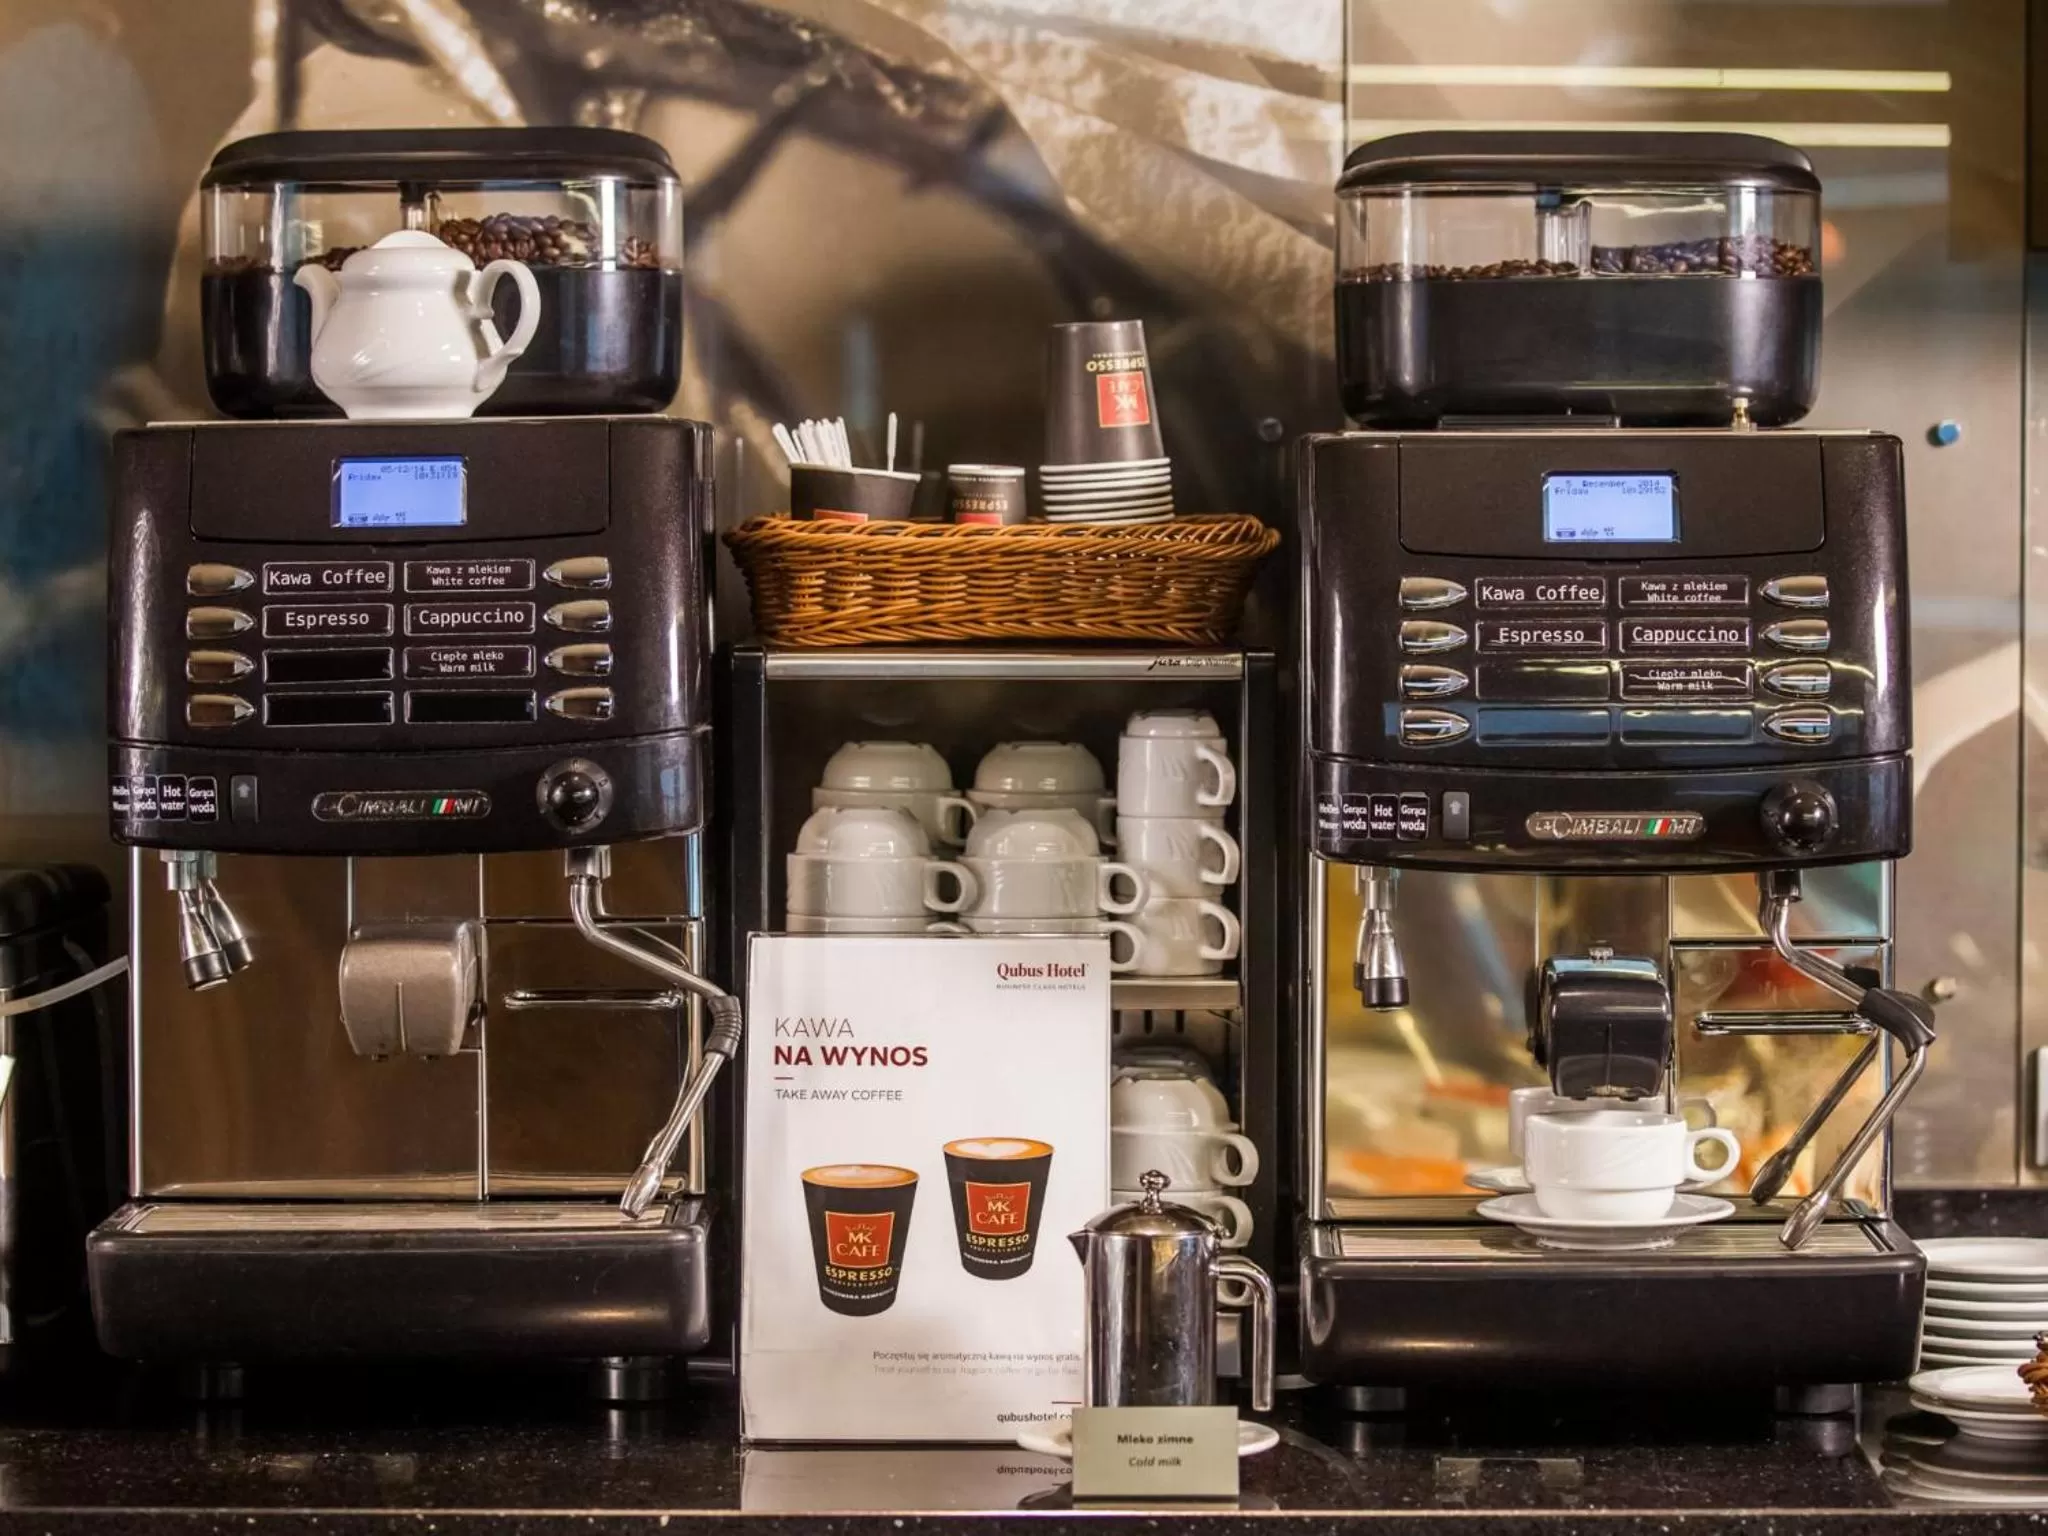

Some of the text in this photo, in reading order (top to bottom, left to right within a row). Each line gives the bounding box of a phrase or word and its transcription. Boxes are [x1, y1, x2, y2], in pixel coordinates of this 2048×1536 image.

[1086, 357, 1146, 372] ESPRESSO
[1582, 480, 1626, 488] December
[1554, 488, 1589, 496] Friday
[426, 566, 450, 574] Kawa
[468, 565, 511, 574] mlekiem
[270, 569, 386, 585] Kawa Coffee
[432, 576, 505, 586] White coffee
[1482, 585, 1600, 600] Kawa Coffee
[1641, 582, 1666, 591] Kawa
[1683, 582, 1728, 591] mlekiem
[1647, 593, 1722, 602] White coffee
[285, 611, 370, 628] Espresso
[418, 609, 525, 627] Cappuccino
[1500, 627, 1584, 645] Espresso
[1632, 626, 1739, 645] Cappuccino
[473, 651, 504, 660] mleko
[439, 663, 495, 673] Warm milk
[1690, 669, 1722, 679] mleko
[1657, 680, 1713, 690] Warm milk
[163, 785, 182, 797] Hot
[133, 799, 157, 810] woda
[160, 801, 185, 811] water
[190, 801, 215, 813] woda
[1374, 804, 1393, 817] Hot
[1343, 818, 1366, 830] woda
[1370, 820, 1396, 830] water
[1400, 819, 1425, 831] woda
[1552, 812, 1641, 839] CIMBALI
[997, 963, 1085, 980] Qubus Hotel
[775, 1017, 854, 1038] KAWA
[774, 1045, 928, 1067] NA WYNOS
[776, 1089, 904, 1101] TAKE AWAY COFFEE
[987, 1201, 1010, 1212] MK
[848, 1232, 872, 1243] MK
[966, 1233, 1029, 1248] ESPRESSO
[825, 1265, 893, 1281] ESPRESSO
[1117, 1434, 1194, 1444] Mleko zimne
[1129, 1456, 1181, 1467] Cold milk
